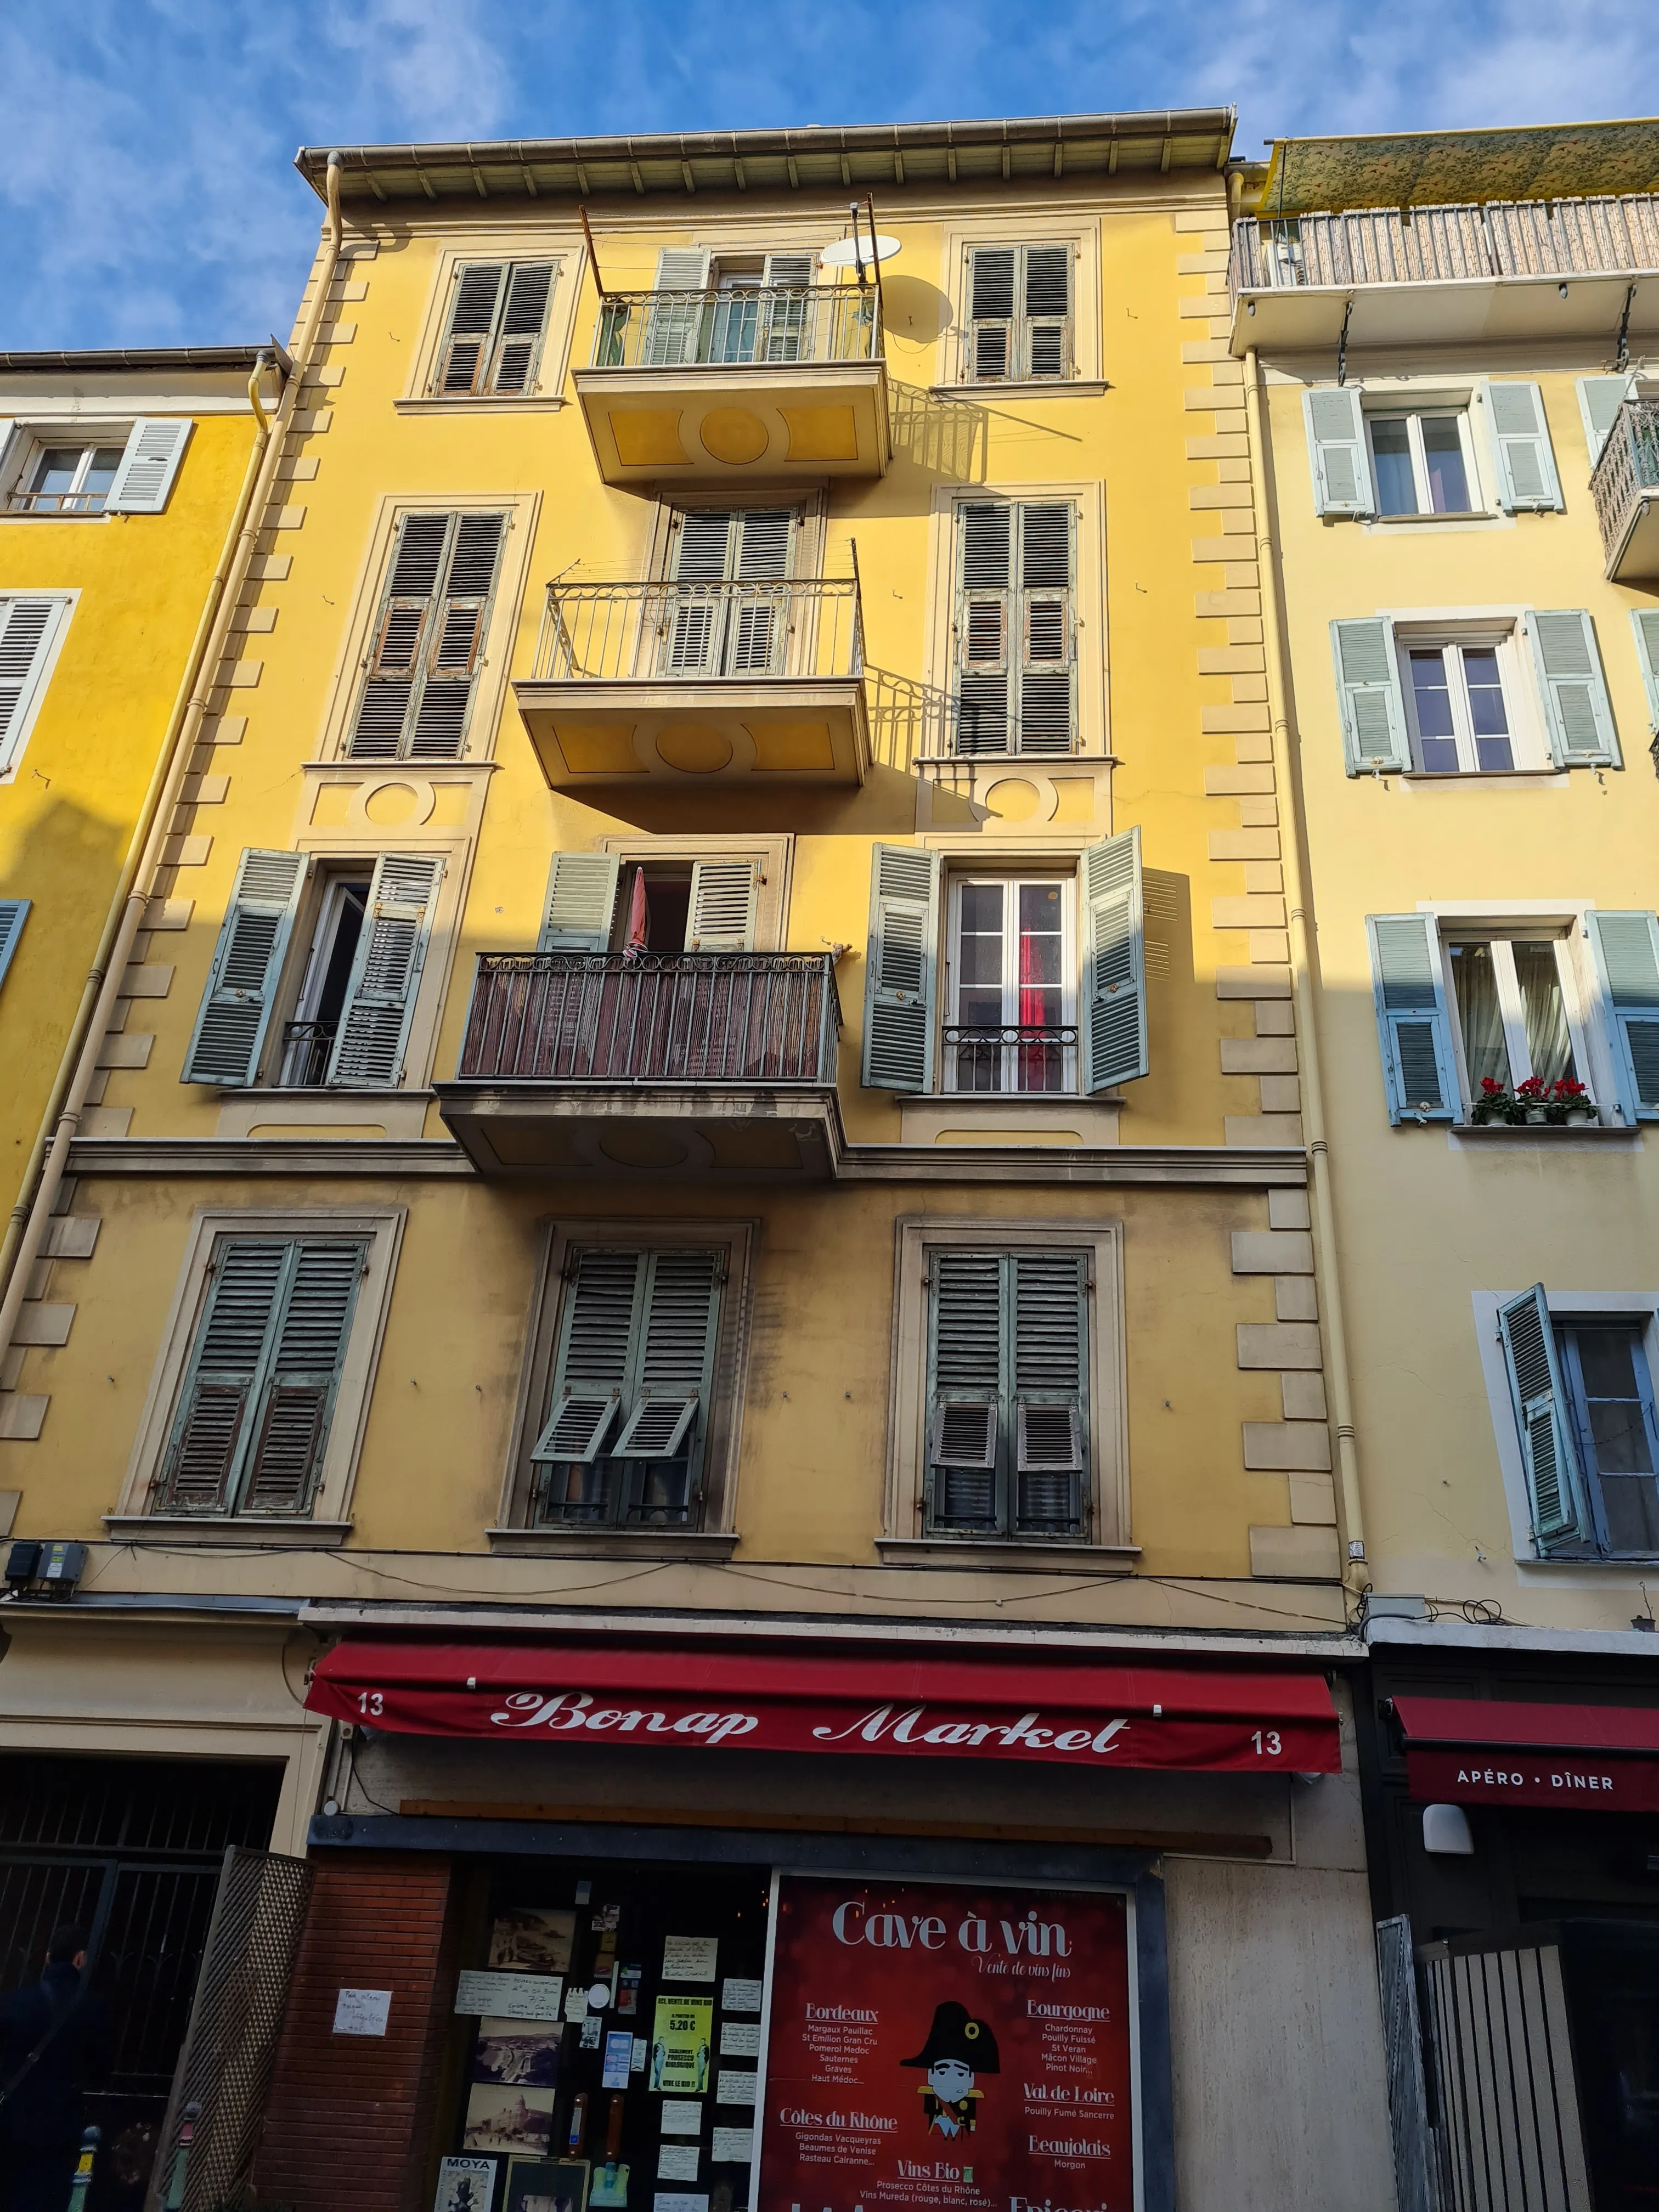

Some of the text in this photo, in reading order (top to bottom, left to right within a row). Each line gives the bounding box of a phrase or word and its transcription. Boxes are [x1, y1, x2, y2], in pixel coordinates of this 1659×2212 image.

[357, 1692, 383, 1716] 13
[490, 1690, 1131, 1754] Bonap Market
[1250, 1730, 1283, 1756] 13
[1457, 1768, 1613, 1790] APÉRO DÎNER
[832, 1900, 1073, 1957] Cave à vin
[972, 1953, 1071, 1982] Vente de vins fins
[805, 2003, 878, 2022] Bordeaux
[1026, 1999, 1110, 2022] Bourgogne
[670, 2020, 687, 2030] 5,20
[808, 2024, 873, 2035] Margaux Pauillac
[1045, 2024, 1093, 2035] Chardonnay
[812, 2035, 840, 2043] Emilion
[1042, 2034, 1096, 2044] Pouilly Fuissé
[844, 2046, 870, 2054] Medoc
[1063, 2045, 1086, 2053] Veran
[820, 2055, 858, 2063] Sauternes
[1041, 2053, 1097, 2065] Mâcon Village
[1046, 2063, 1066, 2072] Pinot
[1023, 2083, 1114, 2103] Val de Loire
[780, 2107, 898, 2130] Côtes du Rhône
[1025, 2107, 1114, 2120] Pouilly Fumé Sancerre
[795, 2132, 881, 2145] Gigondas Vacqueyras
[799, 2143, 876, 2155] Beaumes de Venise
[1028, 2135, 1111, 2157] Beaujolais
[447, 2158, 490, 2169] MOYA
[799, 2153, 831, 2163] Rasteau
[1054, 2159, 1086, 2170] Morgon
[898, 2159, 960, 2180] Vins Bio
[877, 2181, 980, 2195] Prosecco Côtes du Rhône
[860, 2190, 877, 2199] Vins
[879, 2192, 909, 2201] Mureda
[911, 2194, 941, 2204] (rouge,
[944, 2196, 967, 2206] blanc,
